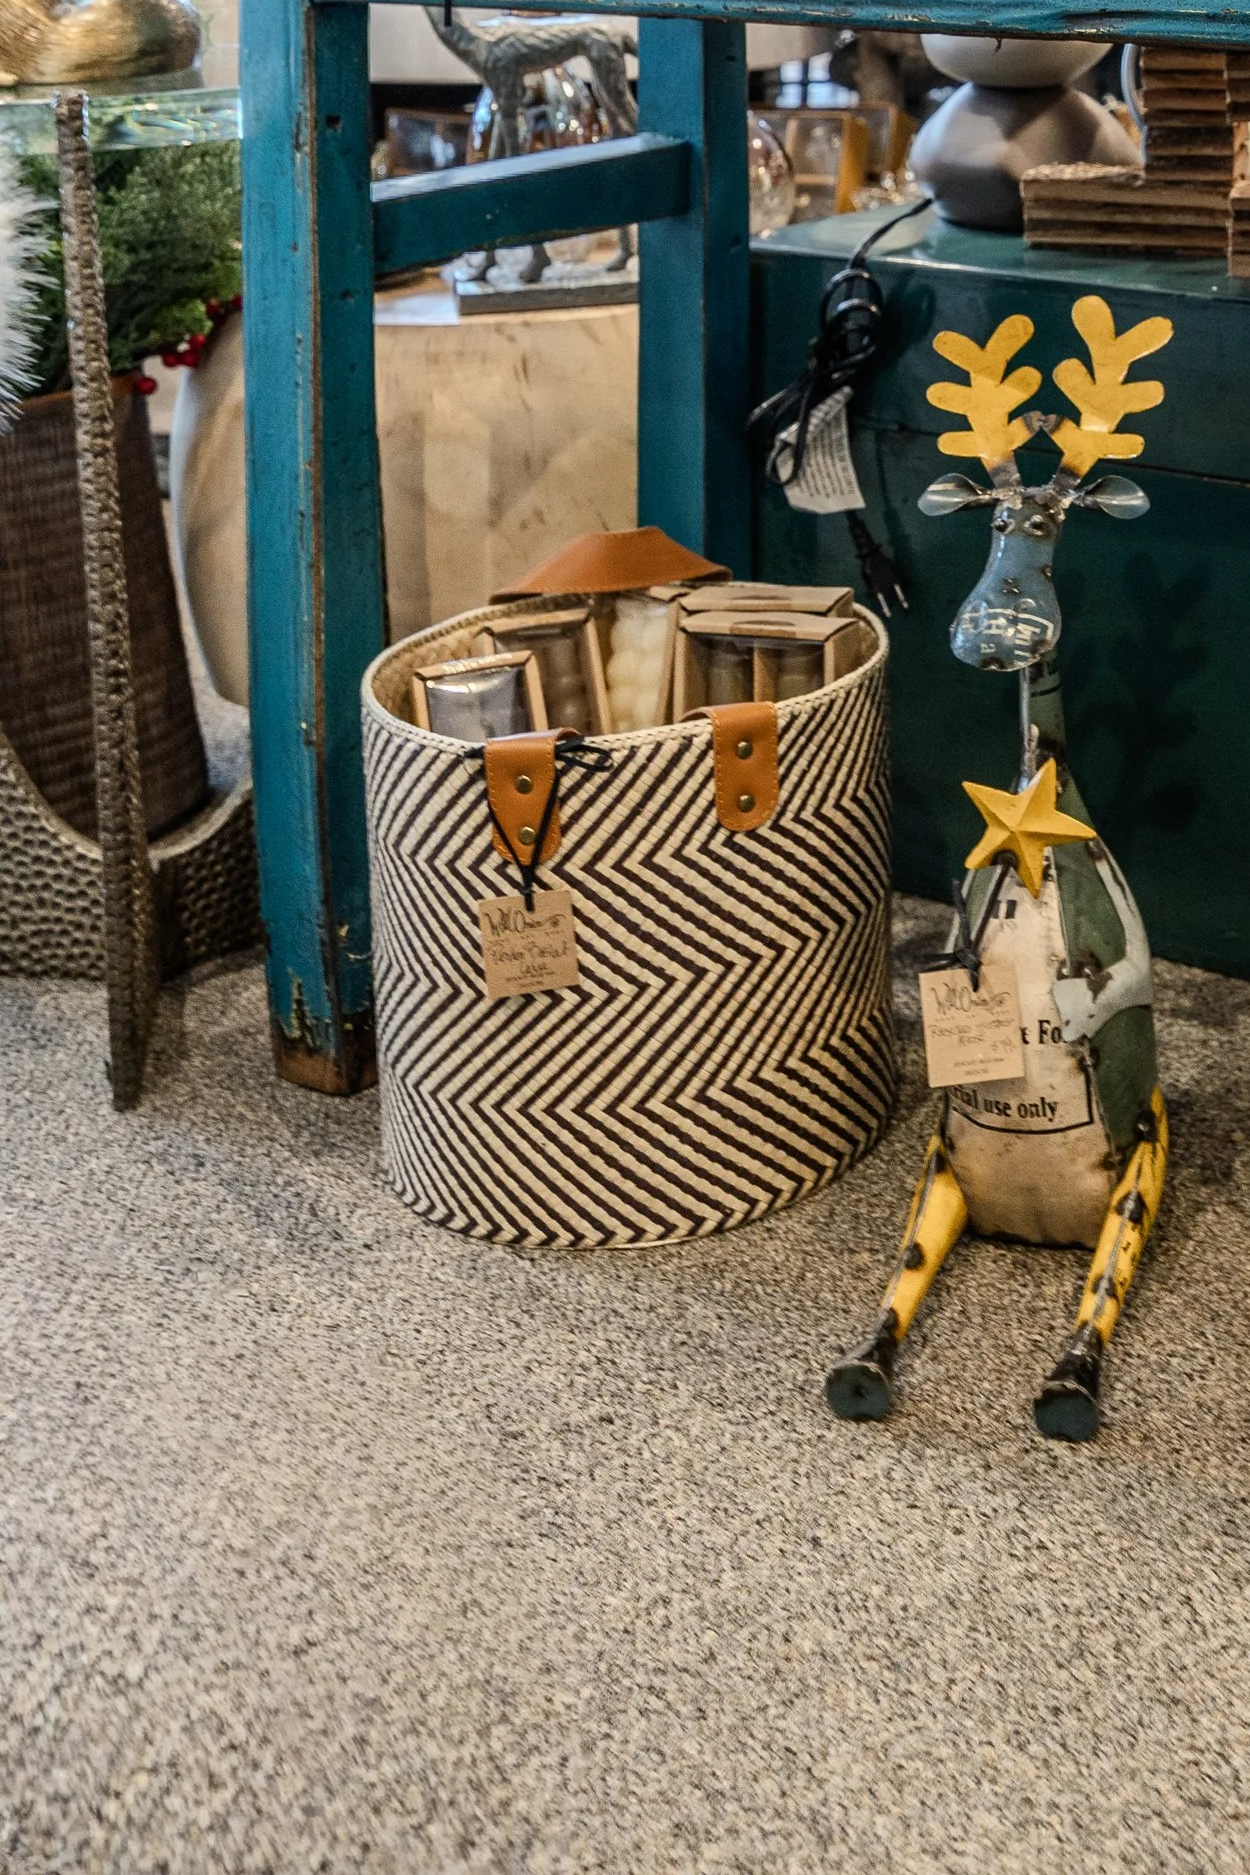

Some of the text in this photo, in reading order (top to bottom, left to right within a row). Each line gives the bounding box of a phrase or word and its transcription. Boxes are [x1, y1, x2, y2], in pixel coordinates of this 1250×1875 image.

[1037, 1019, 1068, 1045] Fo
[952, 1084, 1059, 1123] rial use only
